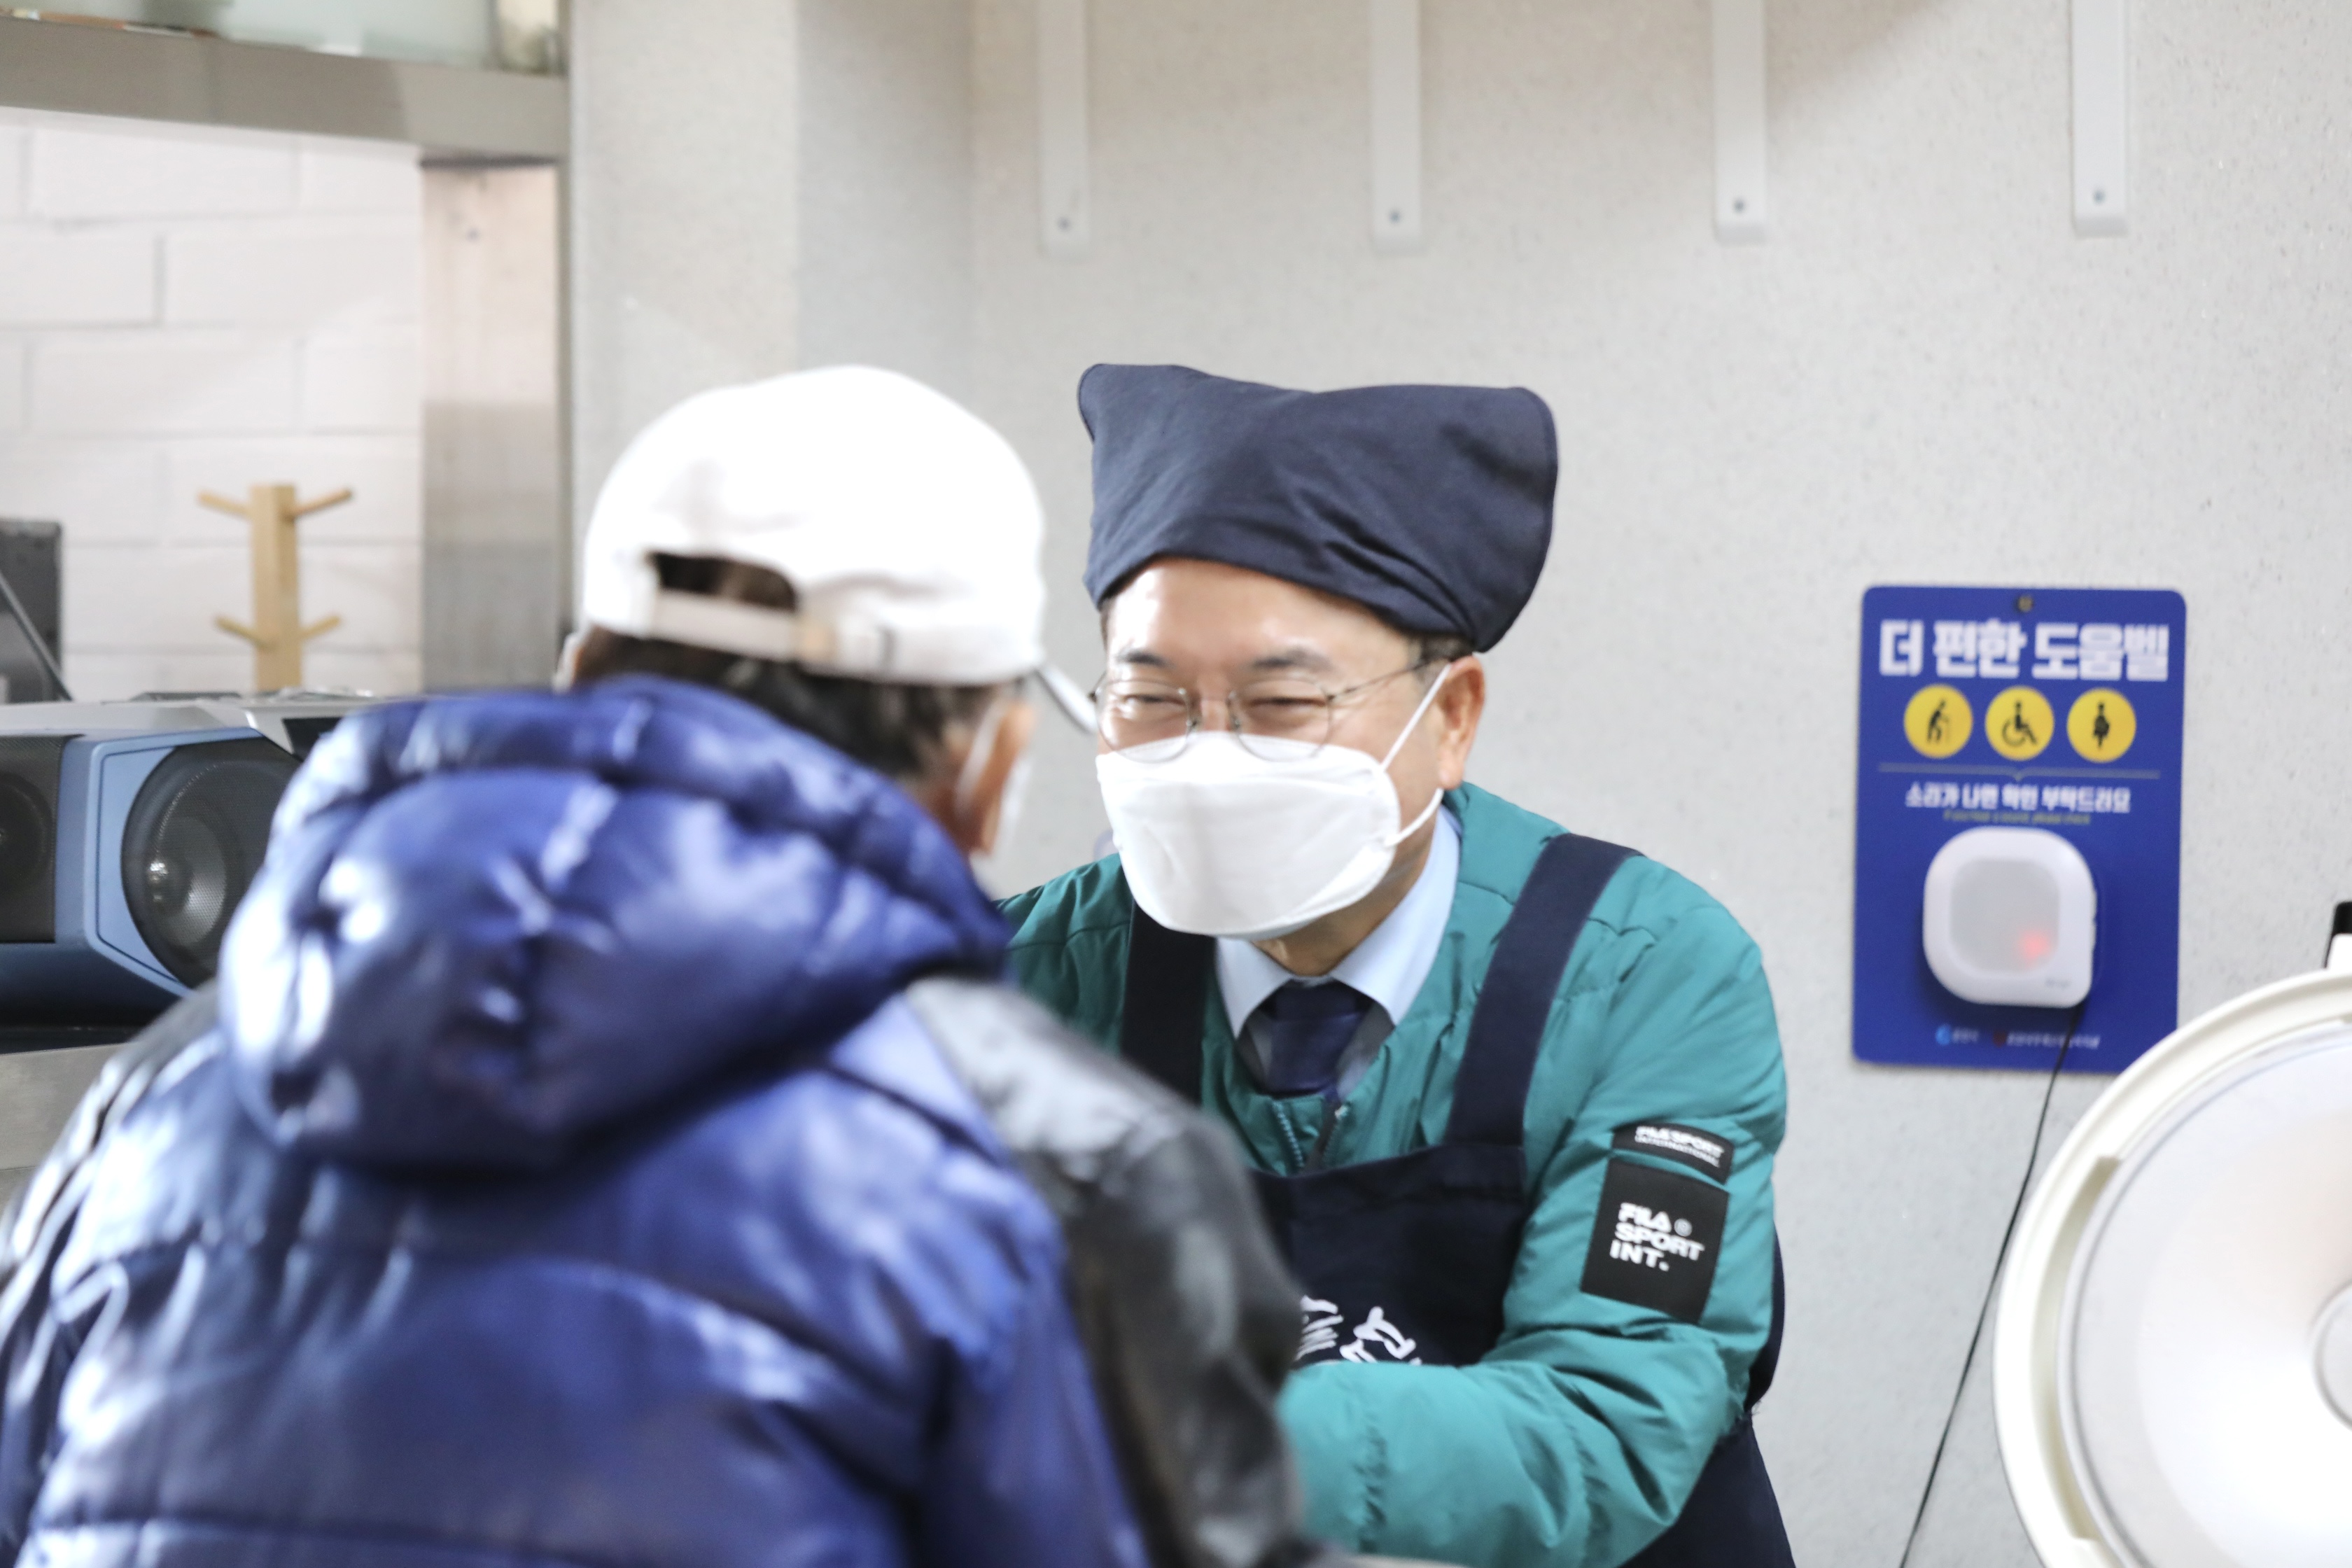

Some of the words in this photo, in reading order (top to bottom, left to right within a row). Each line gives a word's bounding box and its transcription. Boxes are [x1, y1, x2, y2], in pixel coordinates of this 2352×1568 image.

[1878, 619, 1924, 677] 더
[1933, 618, 2027, 679] 편한
[2031, 622, 2170, 682] 도움벨
[1905, 781, 1959, 808] 소리가
[1669, 1129, 1725, 1159] SPORT
[1618, 1202, 1672, 1233] FILA
[1610, 1239, 1670, 1272] INT.
[1615, 1222, 1705, 1261] SPORT
